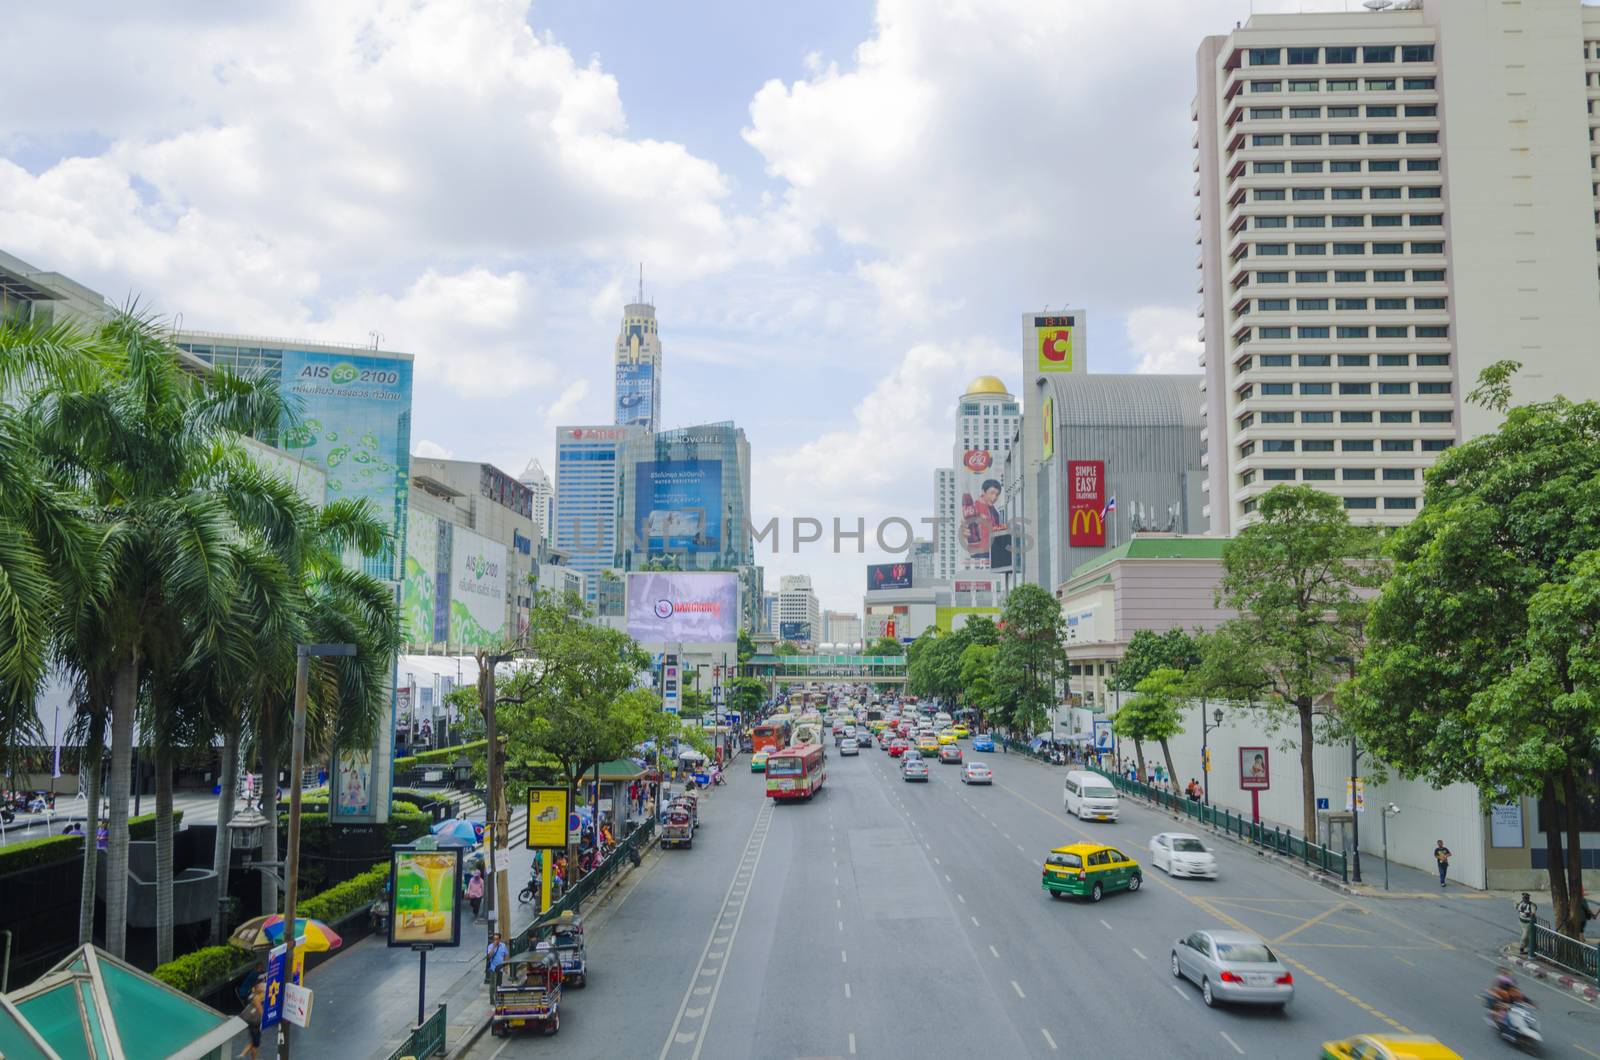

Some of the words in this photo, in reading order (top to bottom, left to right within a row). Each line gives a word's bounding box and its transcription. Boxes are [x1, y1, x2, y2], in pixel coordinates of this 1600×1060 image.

[301, 366, 329, 378] AIS
[334, 367, 354, 379] 3G
[360, 370, 398, 384] 2100
[1075, 465, 1097, 477] SIMPLE
[1075, 477, 1097, 492] EASY
[465, 555, 476, 572] AIS
